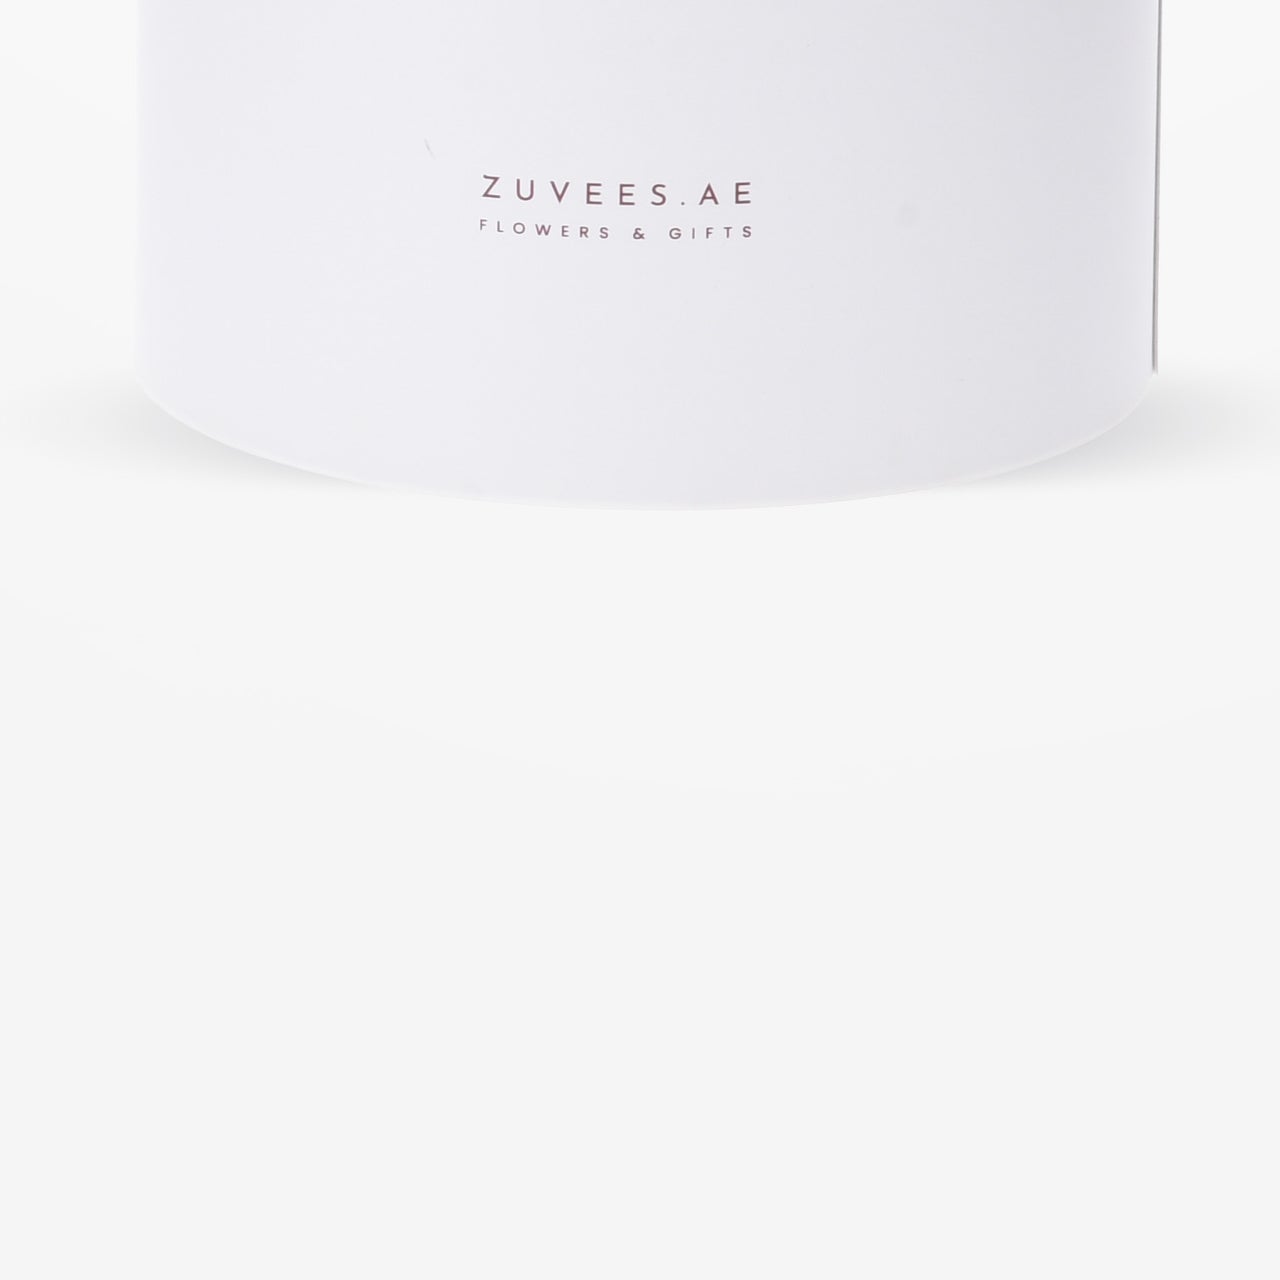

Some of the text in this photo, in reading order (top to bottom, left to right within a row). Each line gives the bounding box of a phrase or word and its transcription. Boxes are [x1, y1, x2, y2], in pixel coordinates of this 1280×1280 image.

[481, 174, 752, 207] ZUVEES.AE
[478, 218, 752, 241] FLOWERS & GIFTS
